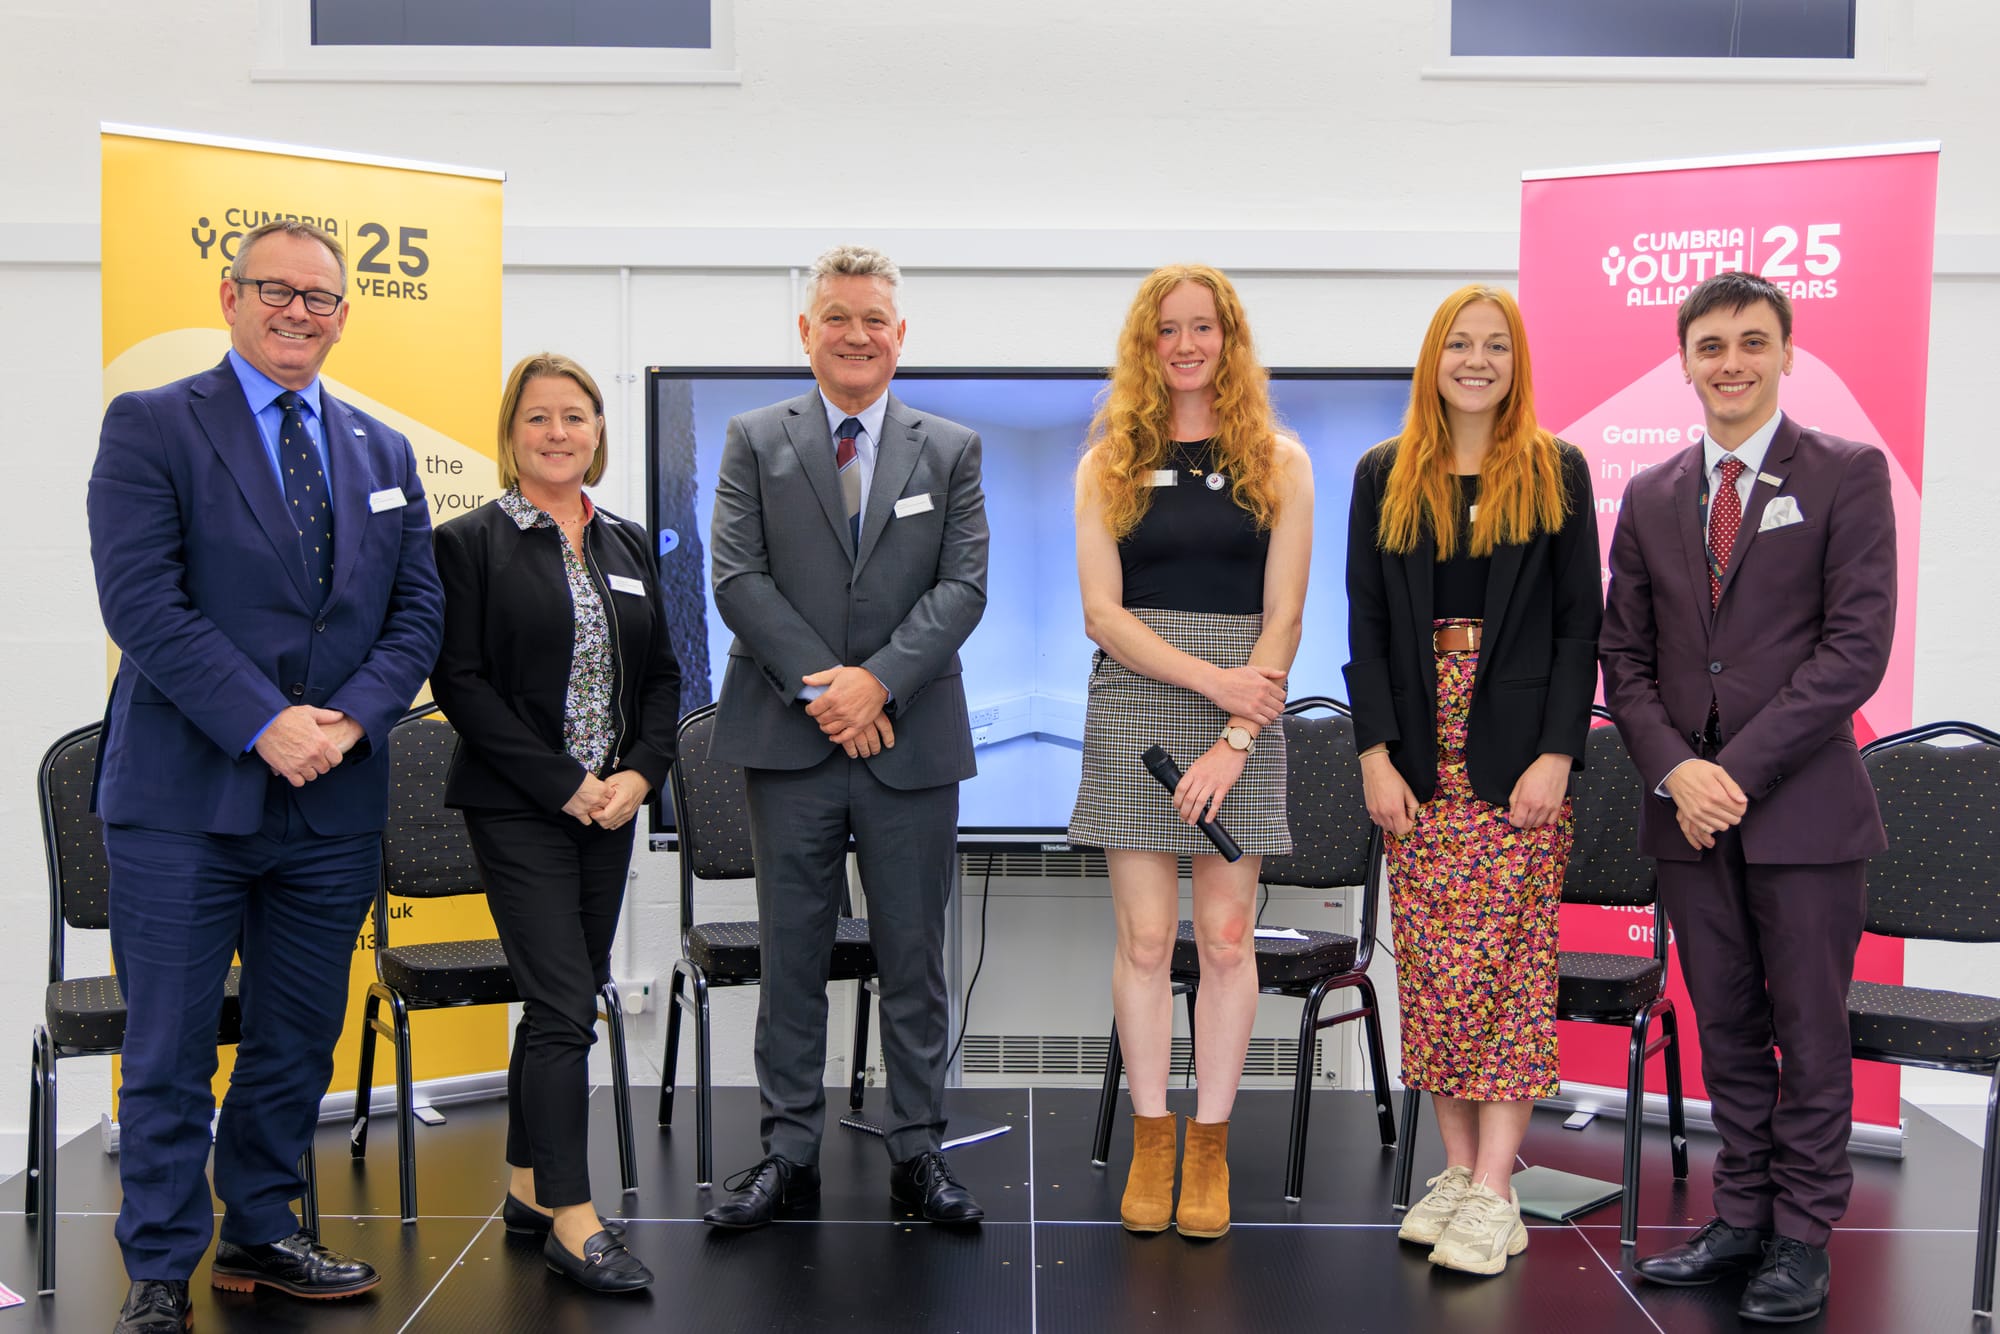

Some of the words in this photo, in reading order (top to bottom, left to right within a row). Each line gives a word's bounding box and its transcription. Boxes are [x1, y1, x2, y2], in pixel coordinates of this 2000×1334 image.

[357, 222, 430, 277] 25
[1633, 228, 1744, 252] CUMBRIA
[1760, 223, 1841, 277] 25
[1602, 246, 1743, 286] YOUTH
[356, 278, 429, 300] YEARS
[1626, 285, 1697, 306] ALLIA
[1775, 279, 1838, 299] EARS
[1602, 425, 1681, 444] Game
[426, 455, 463, 475] the
[1602, 458, 1622, 480] in
[433, 494, 485, 514] your
